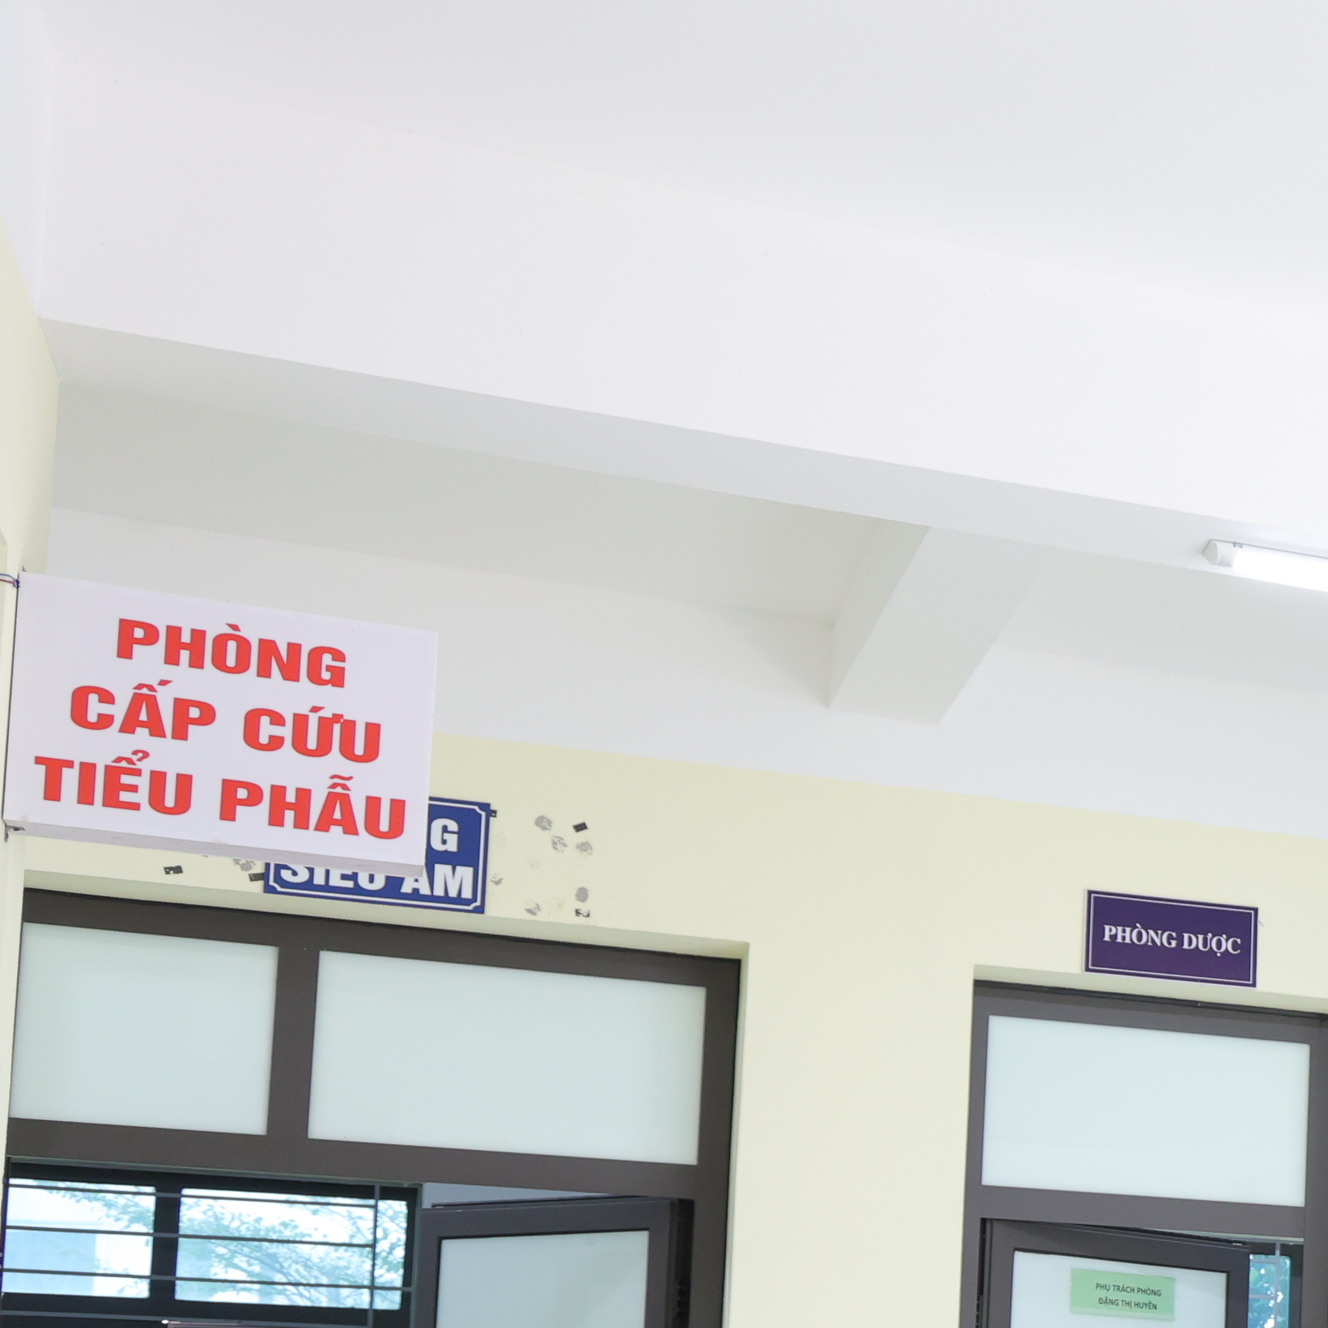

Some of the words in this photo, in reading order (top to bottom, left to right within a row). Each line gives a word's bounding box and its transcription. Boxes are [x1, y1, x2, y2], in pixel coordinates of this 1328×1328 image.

[116, 618, 346, 688] PHÒNG
[70, 679, 216, 741] CẤP
[243, 706, 381, 763] CỨU
[34, 749, 193, 815] TIỂU
[219, 774, 406, 840] PHẪU
[1103, 923, 1177, 948] PHÒNG
[1182, 932, 1241, 957] DƯỢC
